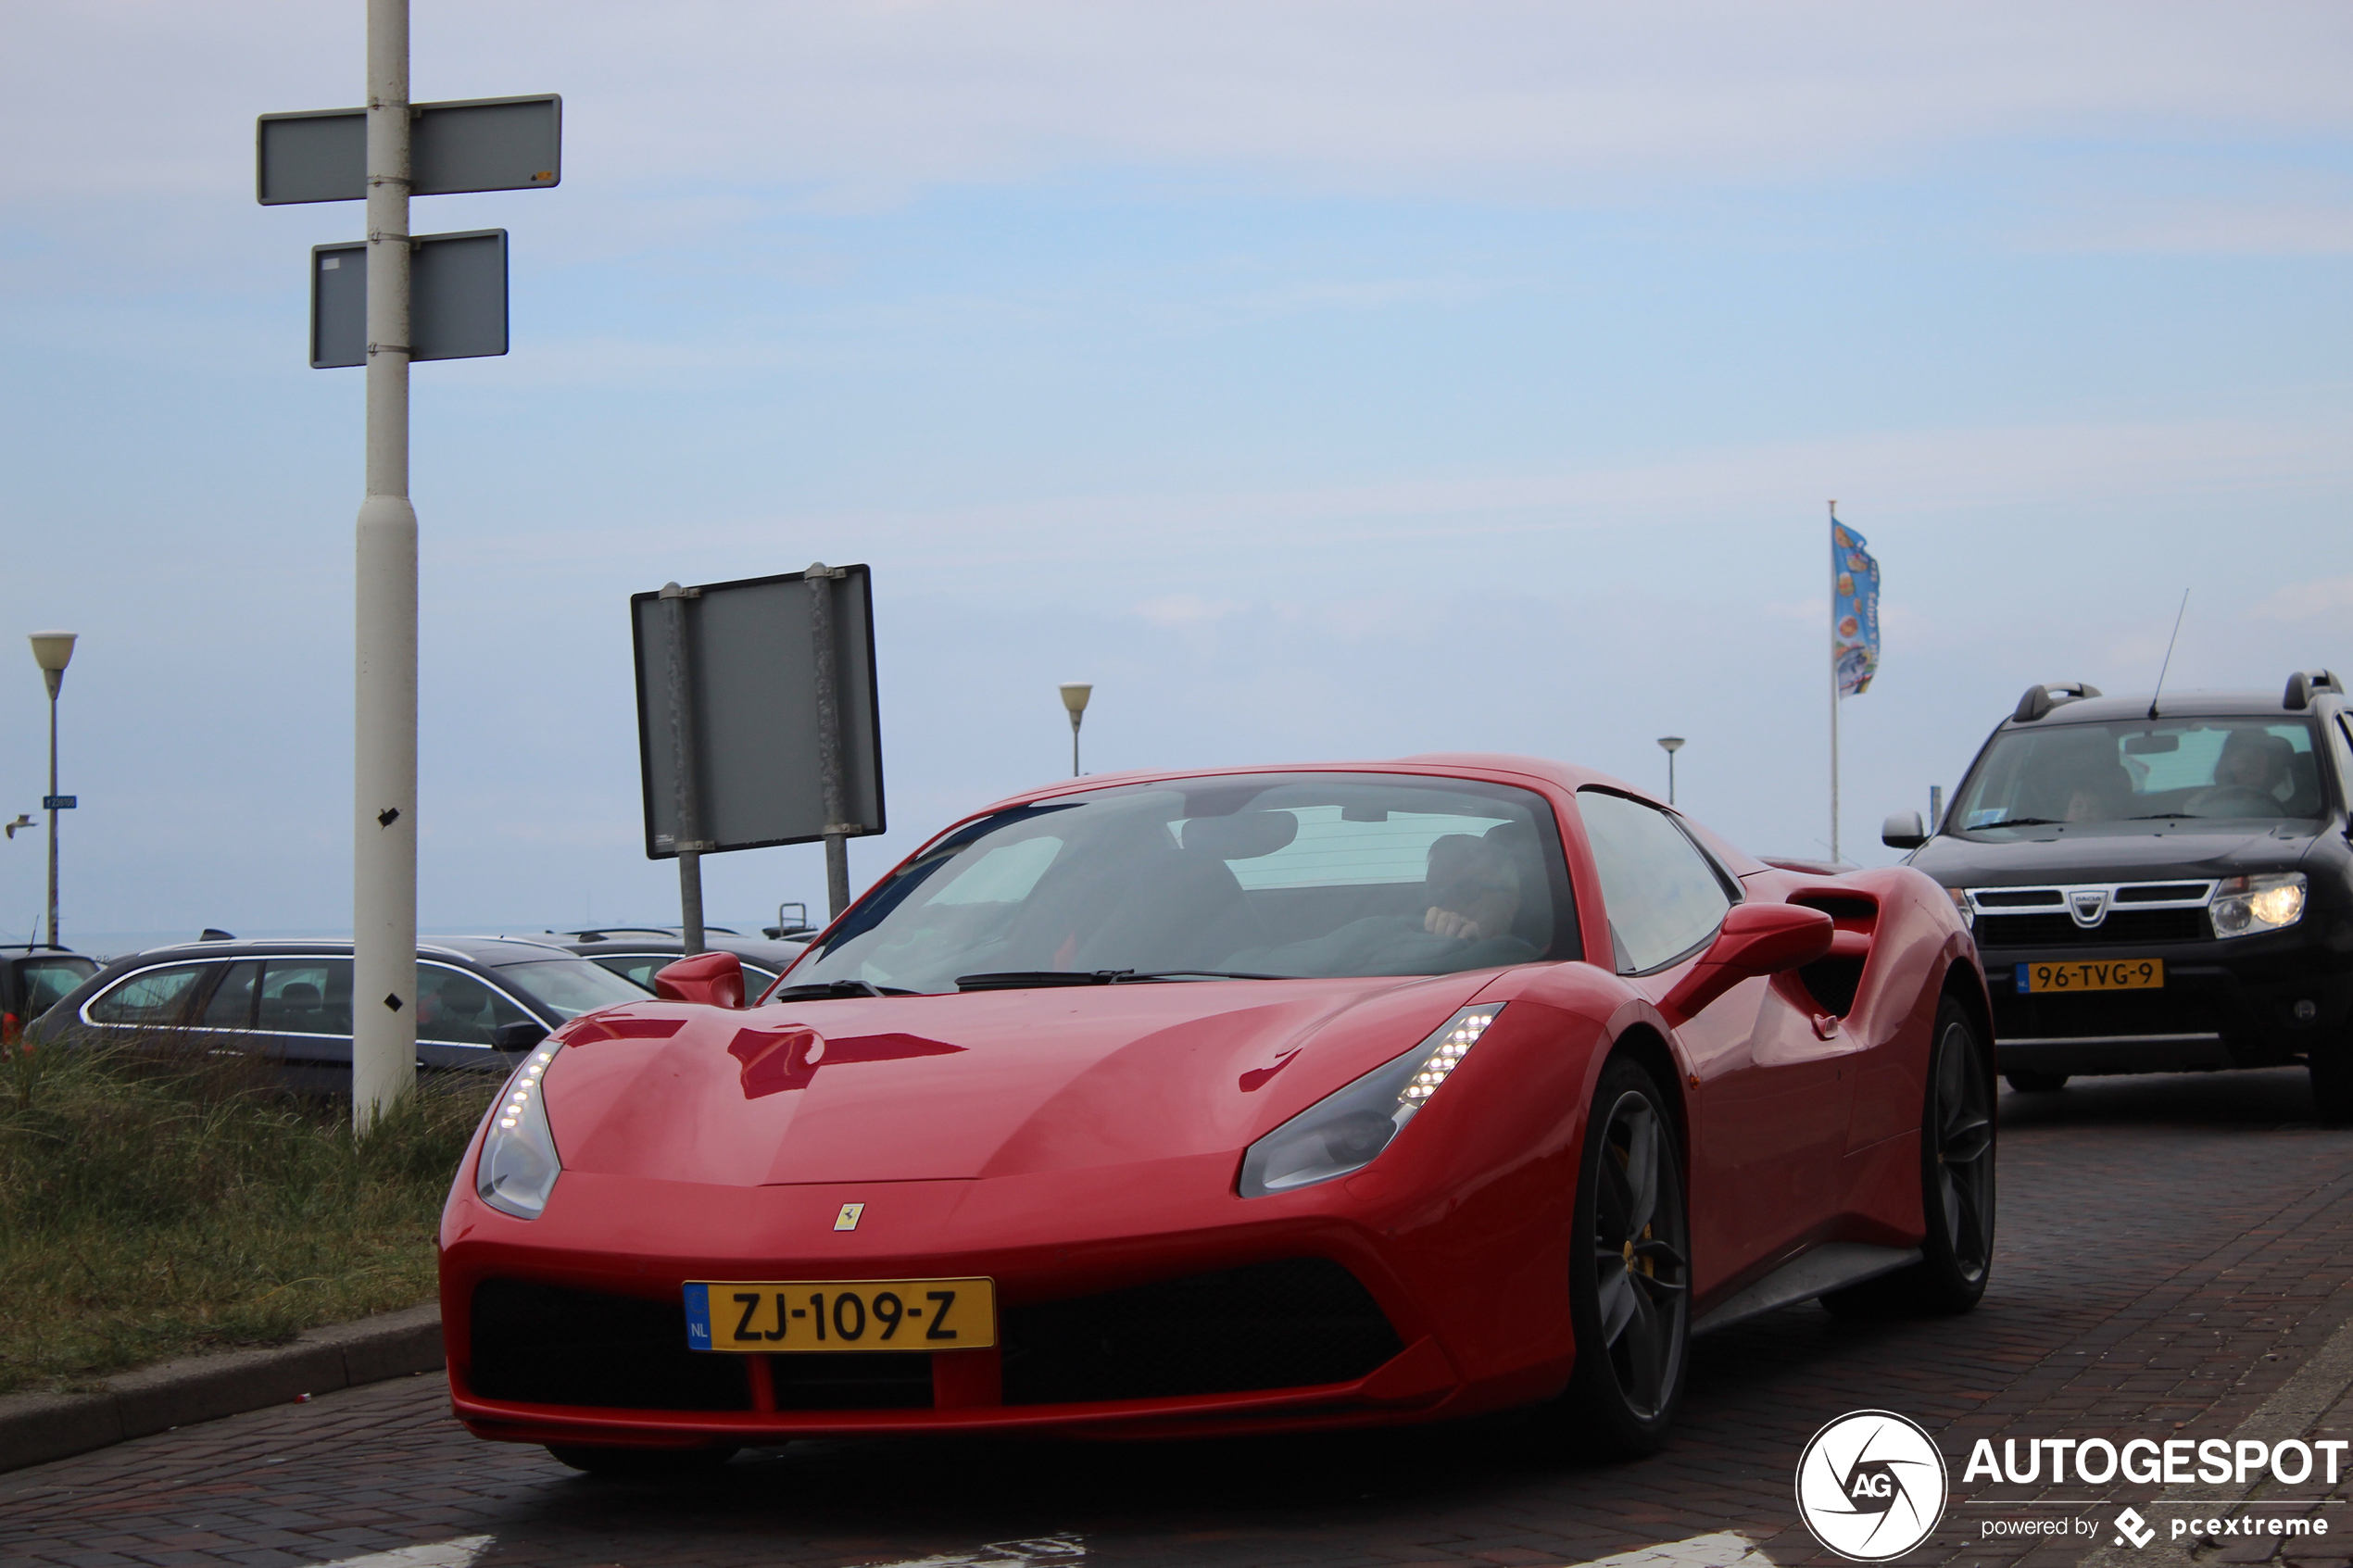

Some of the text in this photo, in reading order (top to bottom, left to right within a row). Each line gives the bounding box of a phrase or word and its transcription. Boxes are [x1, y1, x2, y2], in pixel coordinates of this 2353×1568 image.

[1867, 592, 1877, 628] CHIPS
[2037, 962, 2153, 988] 96-TVG-9
[691, 1323, 708, 1337] NL
[733, 1291, 957, 1341] ZJ-109-Z
